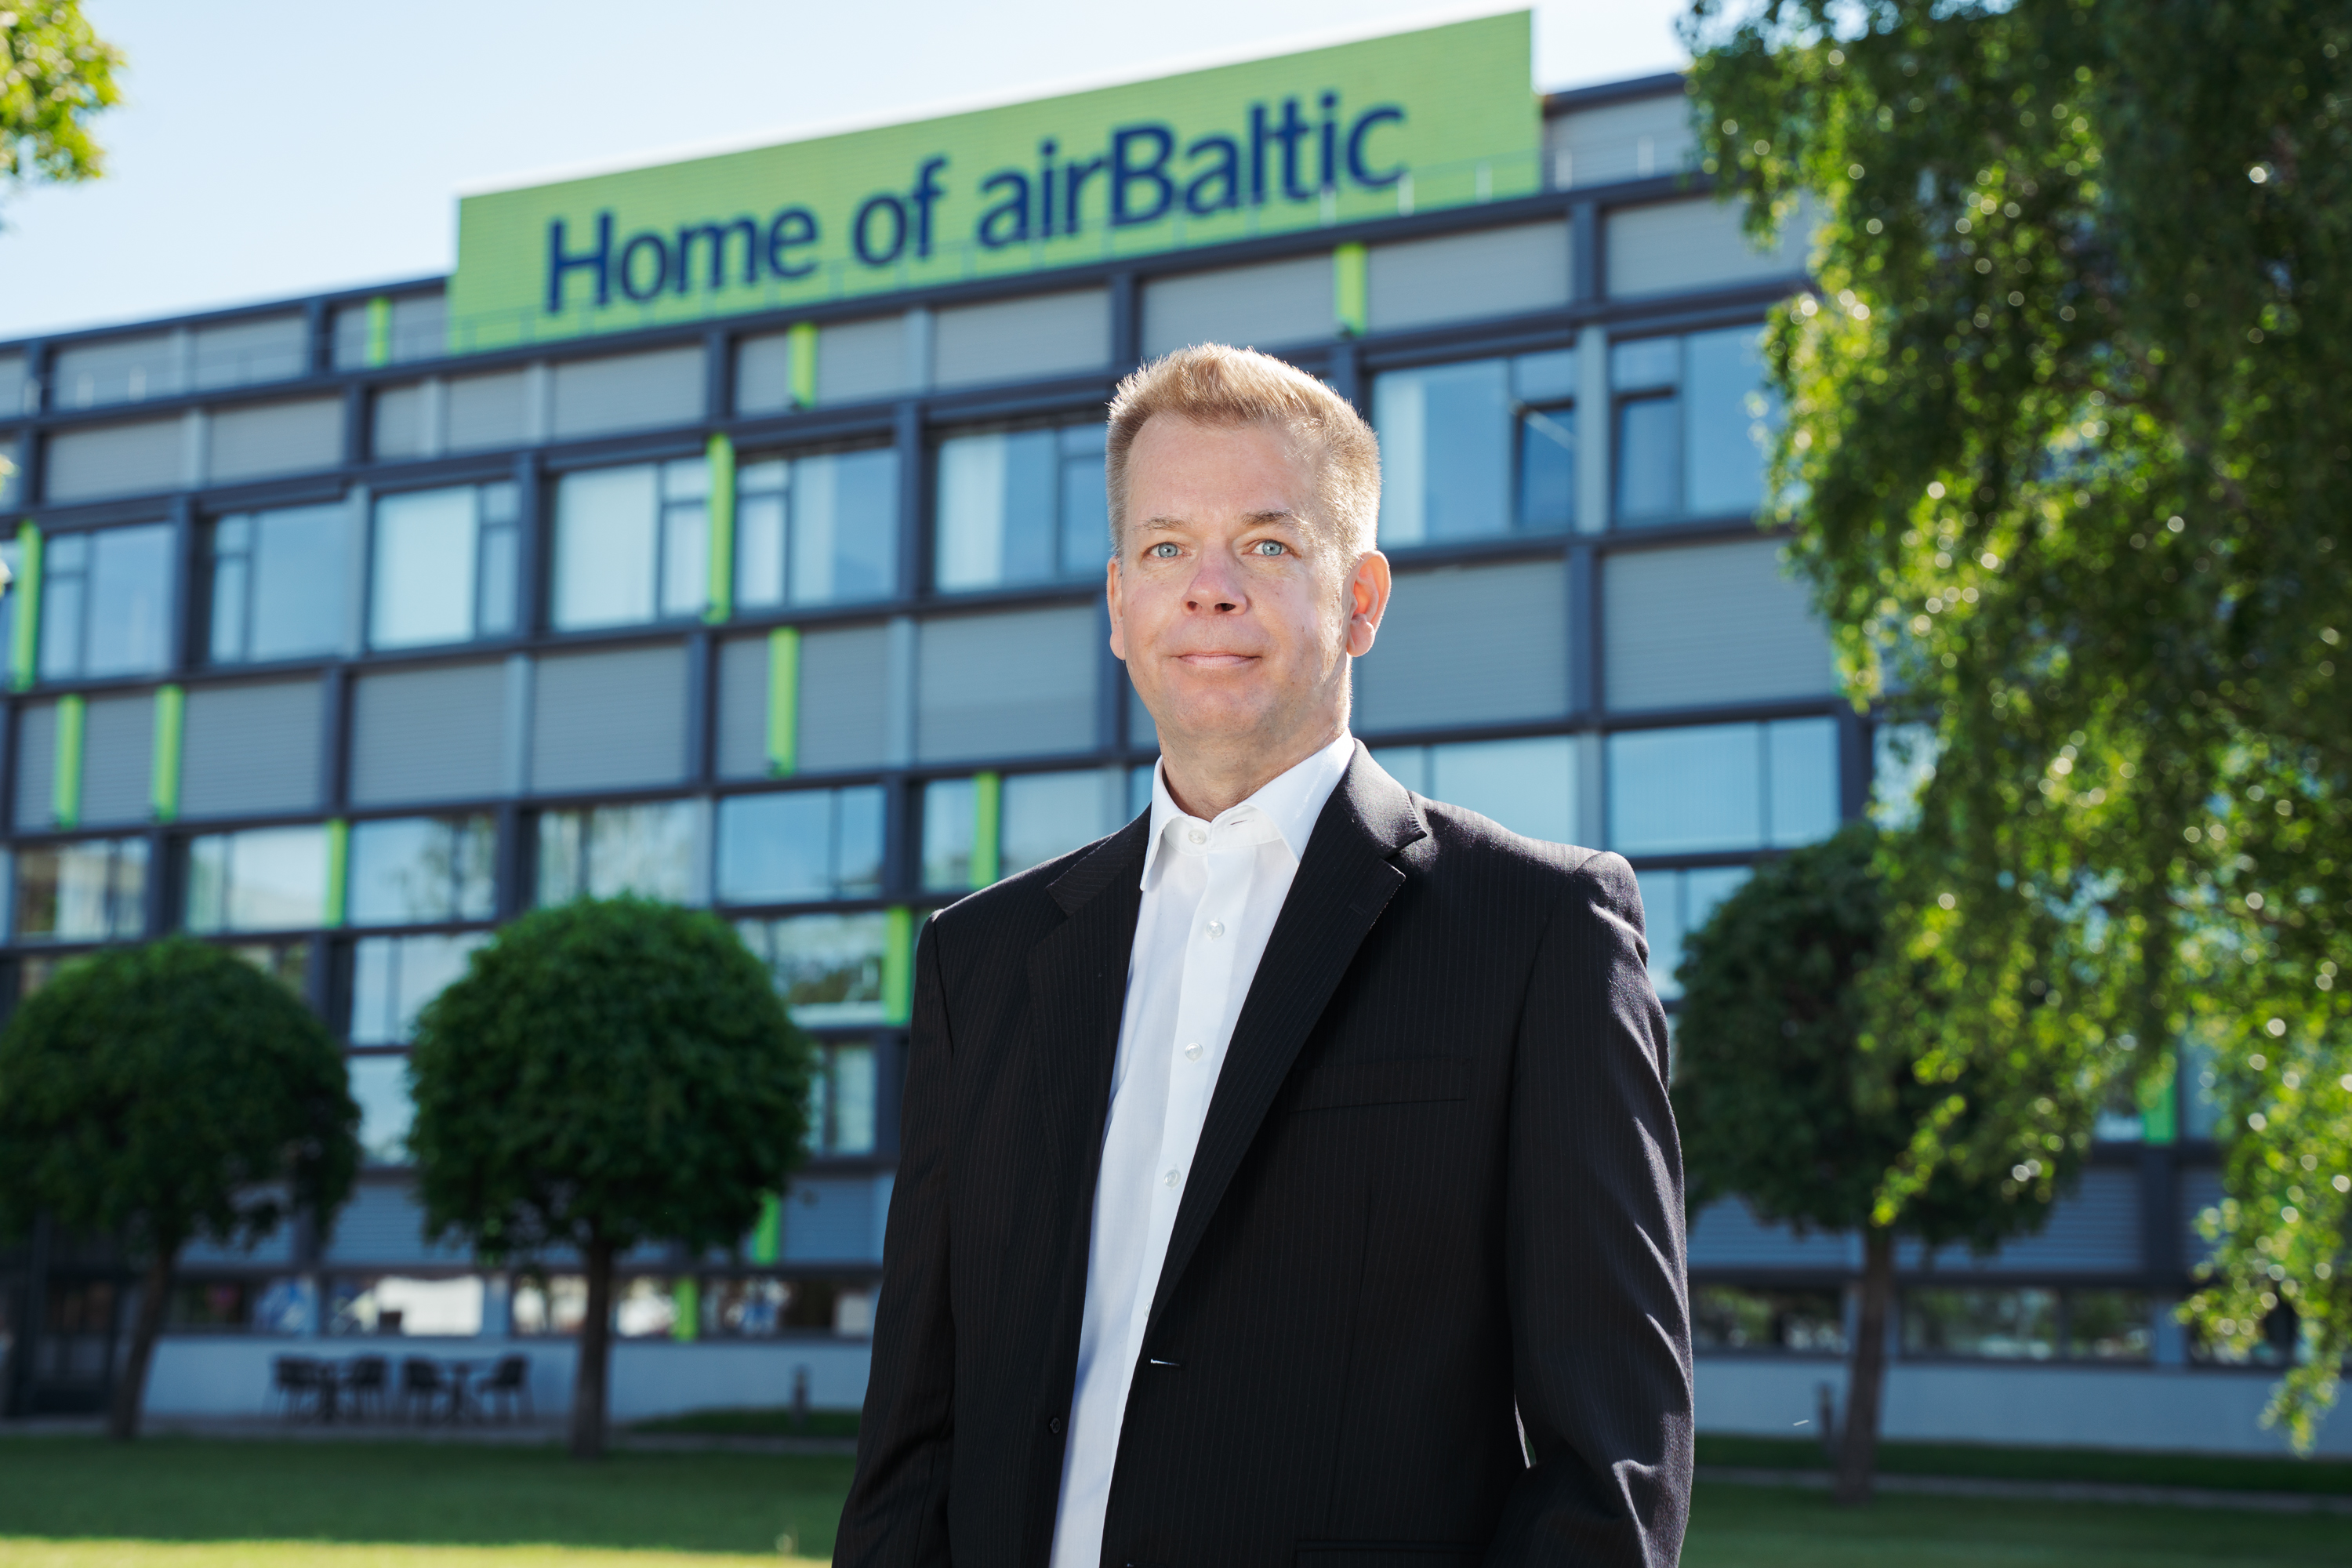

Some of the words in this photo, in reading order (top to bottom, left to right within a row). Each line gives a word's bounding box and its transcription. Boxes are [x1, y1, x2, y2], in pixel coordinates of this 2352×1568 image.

[546, 209, 819, 315] Home
[852, 155, 947, 268] of
[977, 91, 1405, 250] airBaltic
